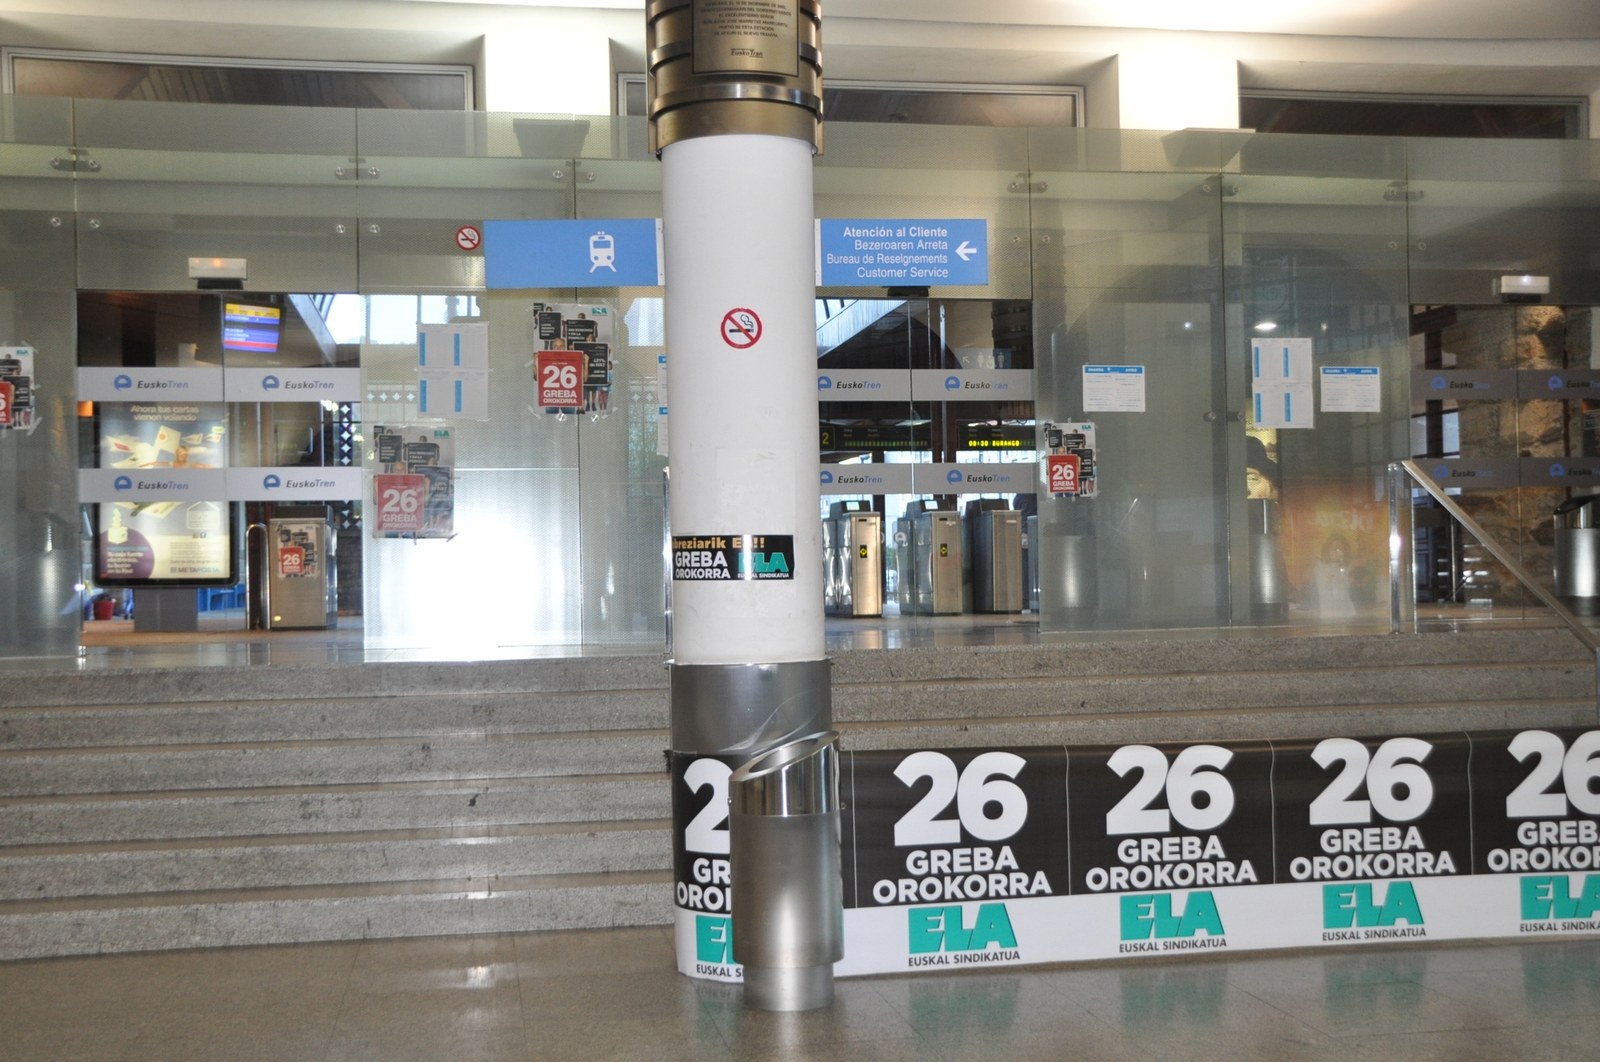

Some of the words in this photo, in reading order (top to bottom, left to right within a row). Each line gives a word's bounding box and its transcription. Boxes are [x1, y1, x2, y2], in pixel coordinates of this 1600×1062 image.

[843, 226, 891, 238] Atención
[896, 226, 906, 238] al
[909, 226, 948, 238] Cliente
[855, 240, 913, 250] Bezeroaren
[916, 240, 948, 250] Arreta
[827, 254, 860, 264] Bureau
[863, 254, 874, 264] de
[857, 267, 906, 278] Customer
[910, 267, 948, 278] Service
[543, 365, 577, 389] 26
[836, 380, 881, 389] EuskoTren
[137, 380, 189, 390] EuskoTren
[285, 380, 334, 390] EuskoTren
[964, 381, 1008, 390] Euskoren
[544, 389, 577, 398] GREBA
[131, 405, 156, 413] Ahora
[158, 405, 171, 413] tus
[173, 406, 199, 414] cartas
[838, 475, 883, 484] EuskoTren
[966, 474, 1011, 483] EuskoTren
[1052, 464, 1074, 480] 26
[137, 481, 189, 490] EuskoTren
[286, 479, 335, 488] EuskoTren
[382, 489, 418, 513] 26
[383, 514, 417, 522] GREBA
[732, 537, 765, 549] E!!
[283, 554, 300, 565] 26
[675, 551, 728, 568] GREBA
[675, 568, 731, 580] OROKORRA
[1309, 737, 1434, 826] 26
[1506, 730, 1600, 818] 26
[1106, 744, 1234, 835] 26
[893, 751, 1028, 847] 26
[1320, 826, 1424, 854] GREBA
[1517, 820, 1600, 846] GREB
[1117, 835, 1225, 864] GREBA
[905, 845, 1019, 876] GREBA
[1289, 850, 1456, 882] OROKORRA
[1085, 859, 1258, 892] OROKORRA
[872, 870, 1053, 905] OROKORRA
[1322, 881, 1424, 929] ELA
[1119, 890, 1225, 941] ELA
[908, 903, 1019, 954] ELA
[1322, 930, 1361, 942] EUSKAL
[1364, 927, 1427, 940] SINDIKATUA
[1520, 922, 1558, 932] EUSKAL
[1119, 939, 1160, 953] EUSKAL
[1162, 937, 1227, 952] SINDIKATUA
[908, 954, 950, 967] EUSKAL
[953, 950, 1021, 965] SINDIKATUA
[696, 964, 732, 978] EUSKAL
